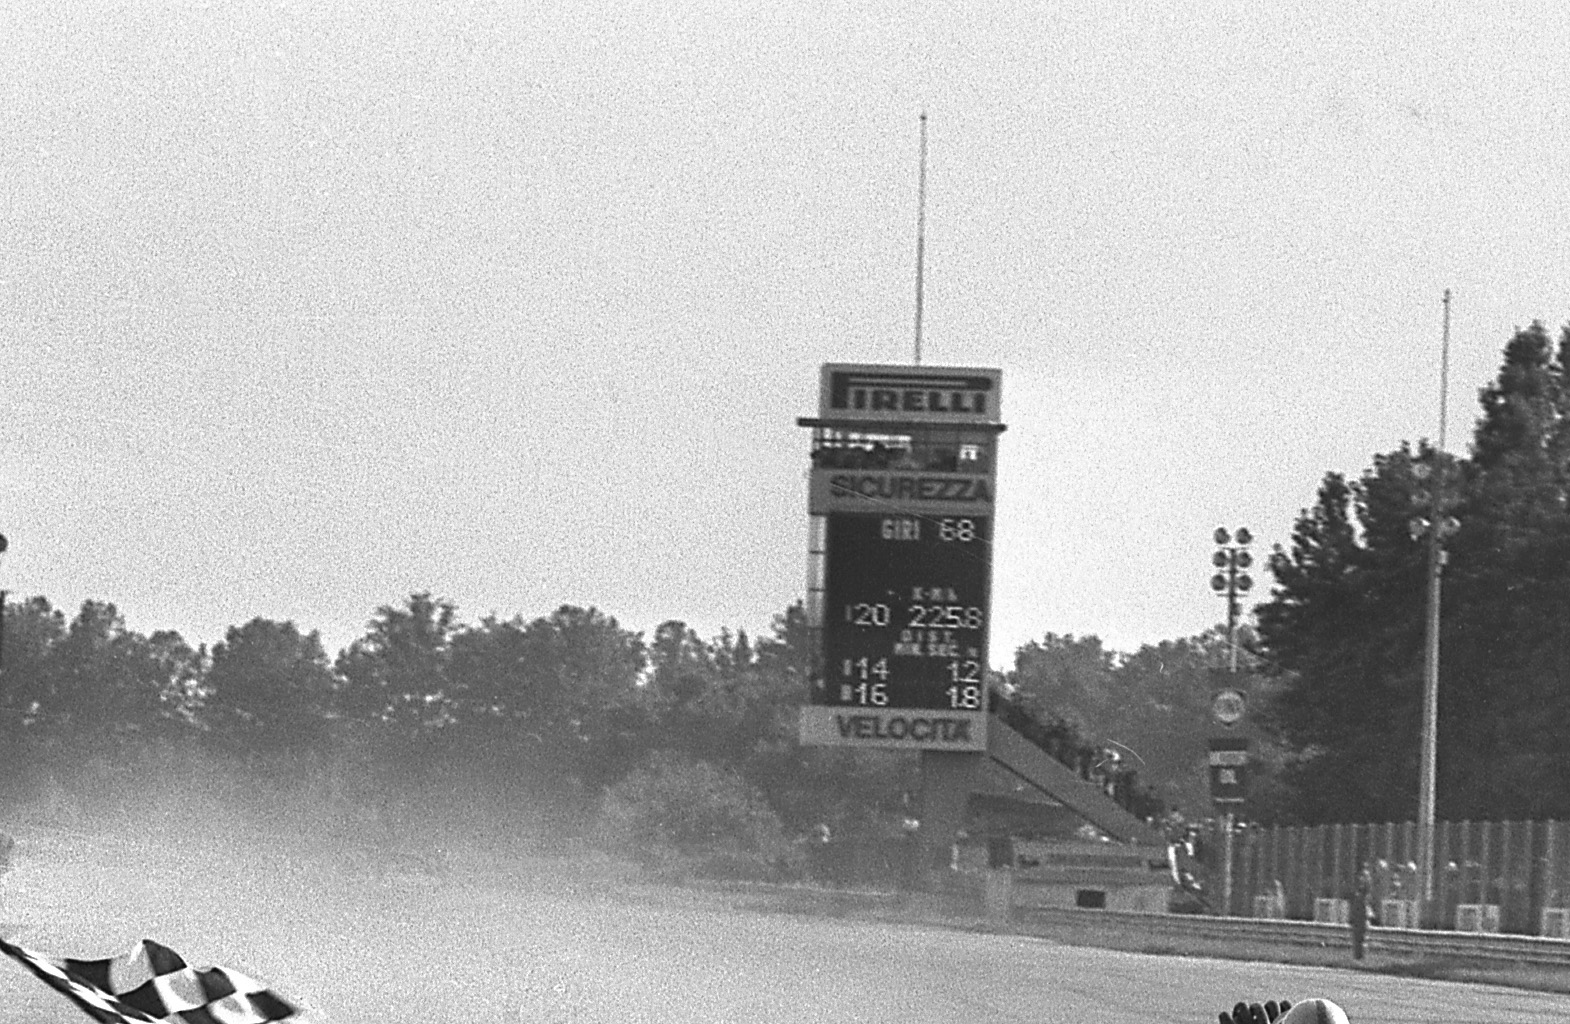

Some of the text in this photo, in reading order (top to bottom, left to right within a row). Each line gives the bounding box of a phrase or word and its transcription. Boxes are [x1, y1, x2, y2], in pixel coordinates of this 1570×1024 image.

[831, 371, 992, 414] PIRELLI
[938, 517, 975, 541] 68
[853, 603, 889, 626] 20
[907, 604, 982, 629] 2258
[855, 657, 889, 681] 14
[947, 660, 980, 684] 12
[855, 682, 889, 706] 16
[946, 686, 980, 709] 18
